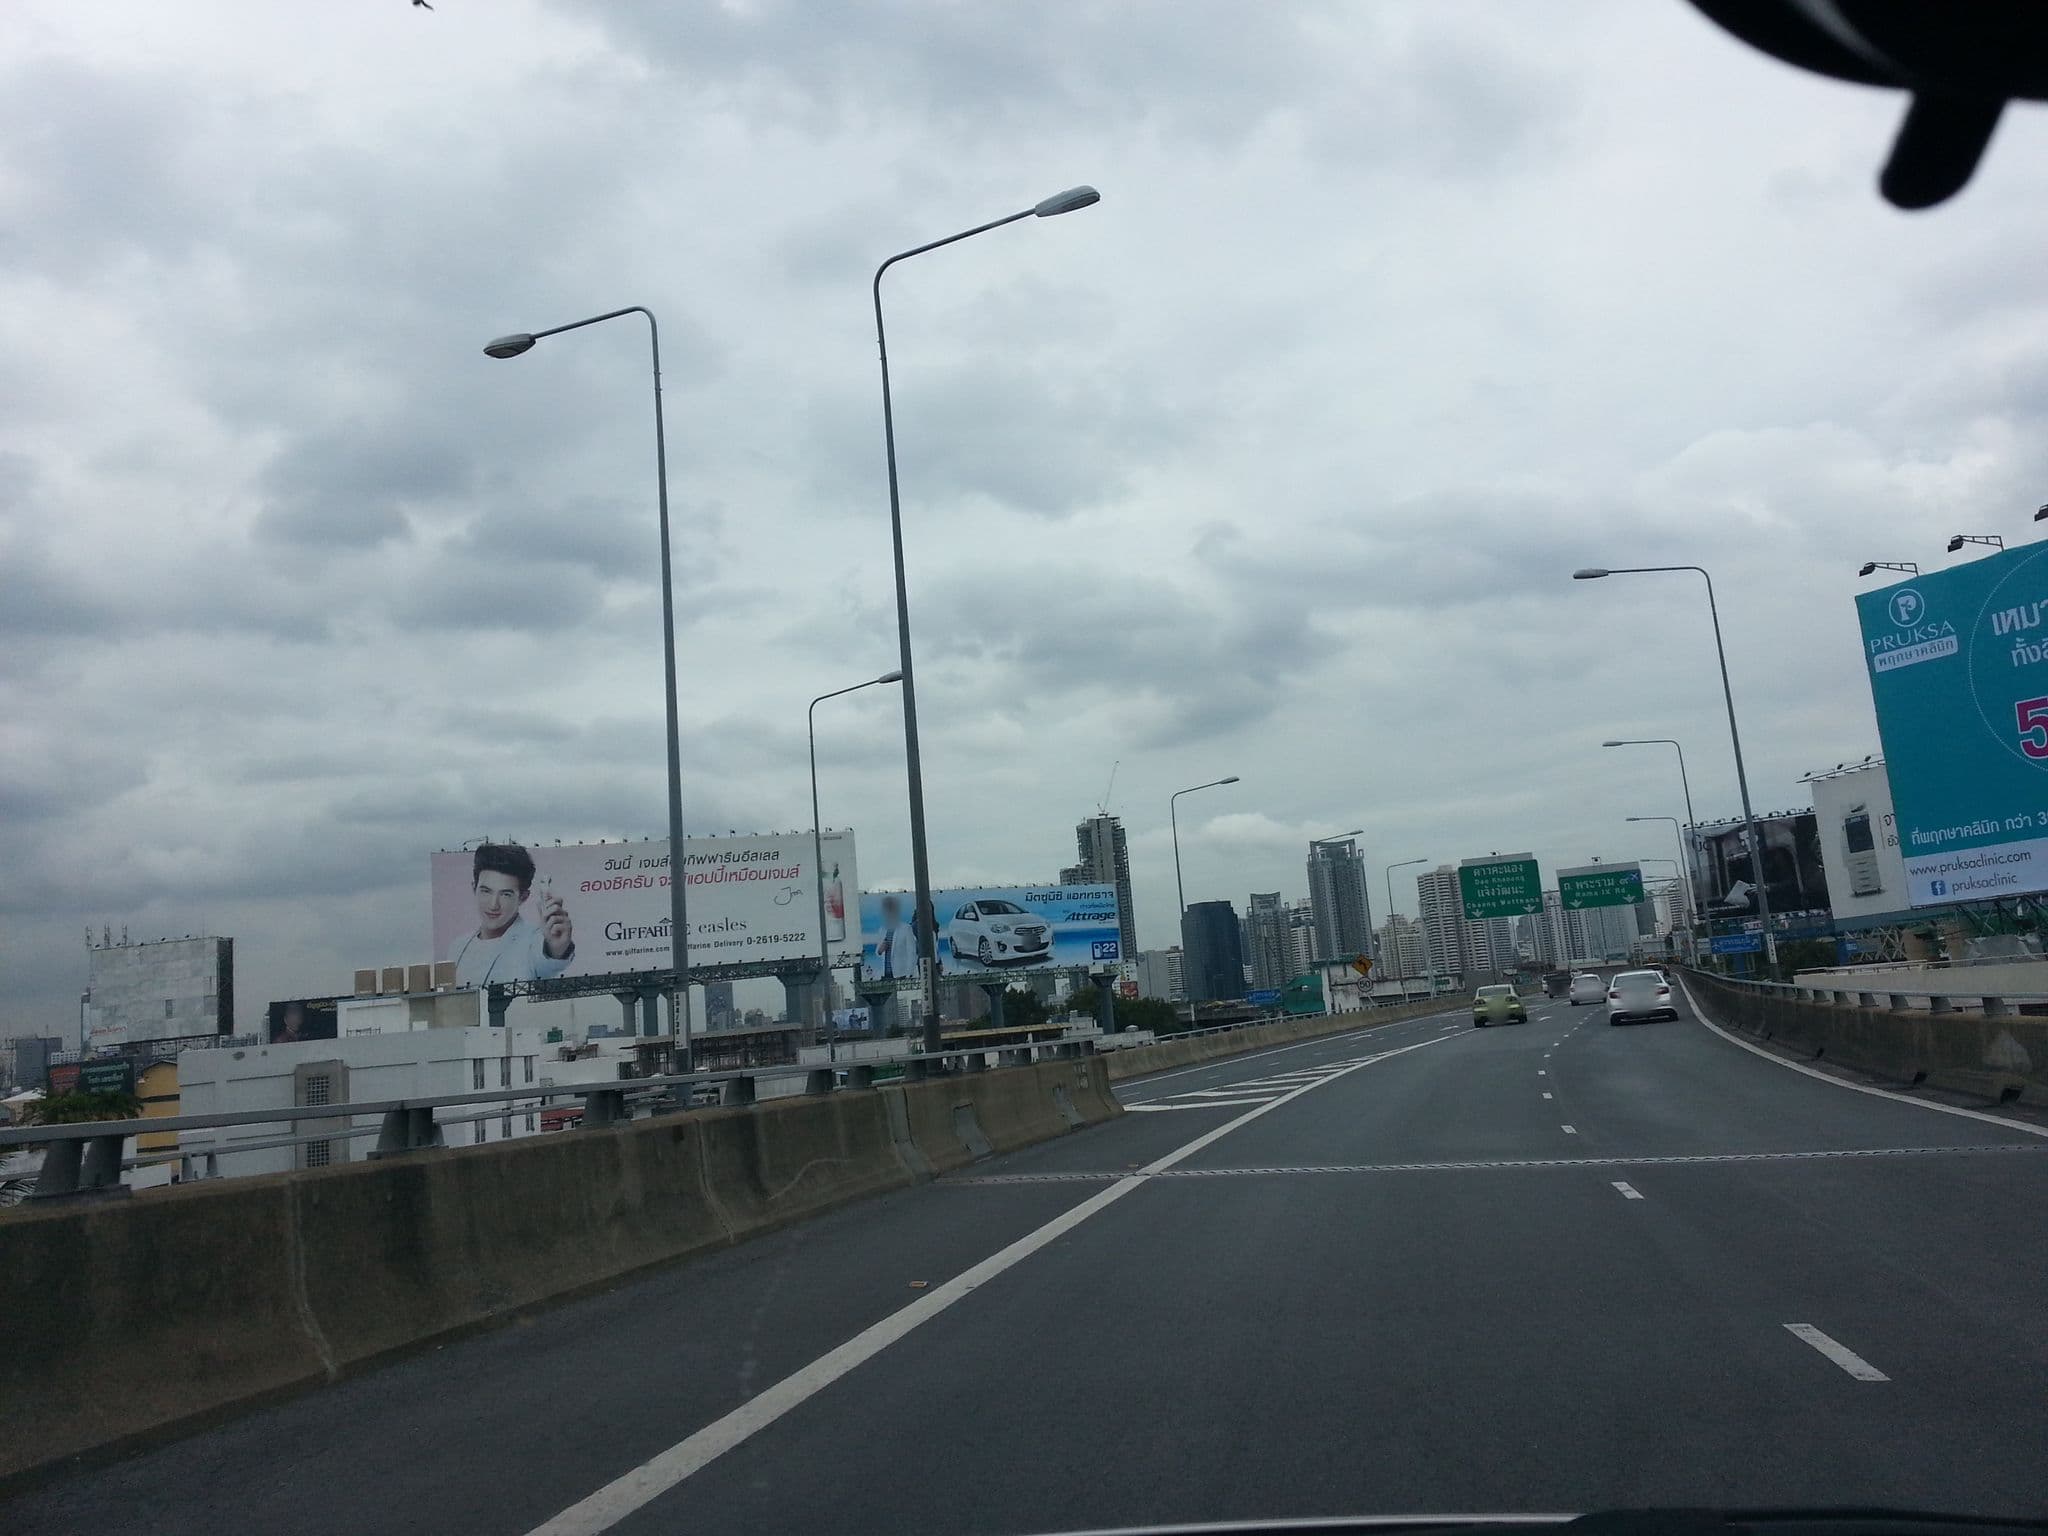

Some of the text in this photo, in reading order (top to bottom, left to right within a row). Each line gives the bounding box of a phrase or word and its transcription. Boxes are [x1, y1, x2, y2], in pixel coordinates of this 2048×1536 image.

[1870, 620, 1955, 653] PRUKSA
[1878, 640, 1954, 667] พฤกษาคลินิก
[1911, 811, 2048, 846] ที่พฤกษาคลินิก กว่า 3
[603, 855, 633, 871] วันนี้
[1909, 850, 2032, 877] www.pruksaclinic.com
[1952, 872, 2018, 896] pruksaclinic
[1065, 911, 1116, 922] Attrage
[605, 945, 671, 957] www.giffarine.com
[713, 938, 744, 949] Delivery
[746, 932, 807, 946] 0-2619-5222
[1102, 943, 1117, 953] 22
